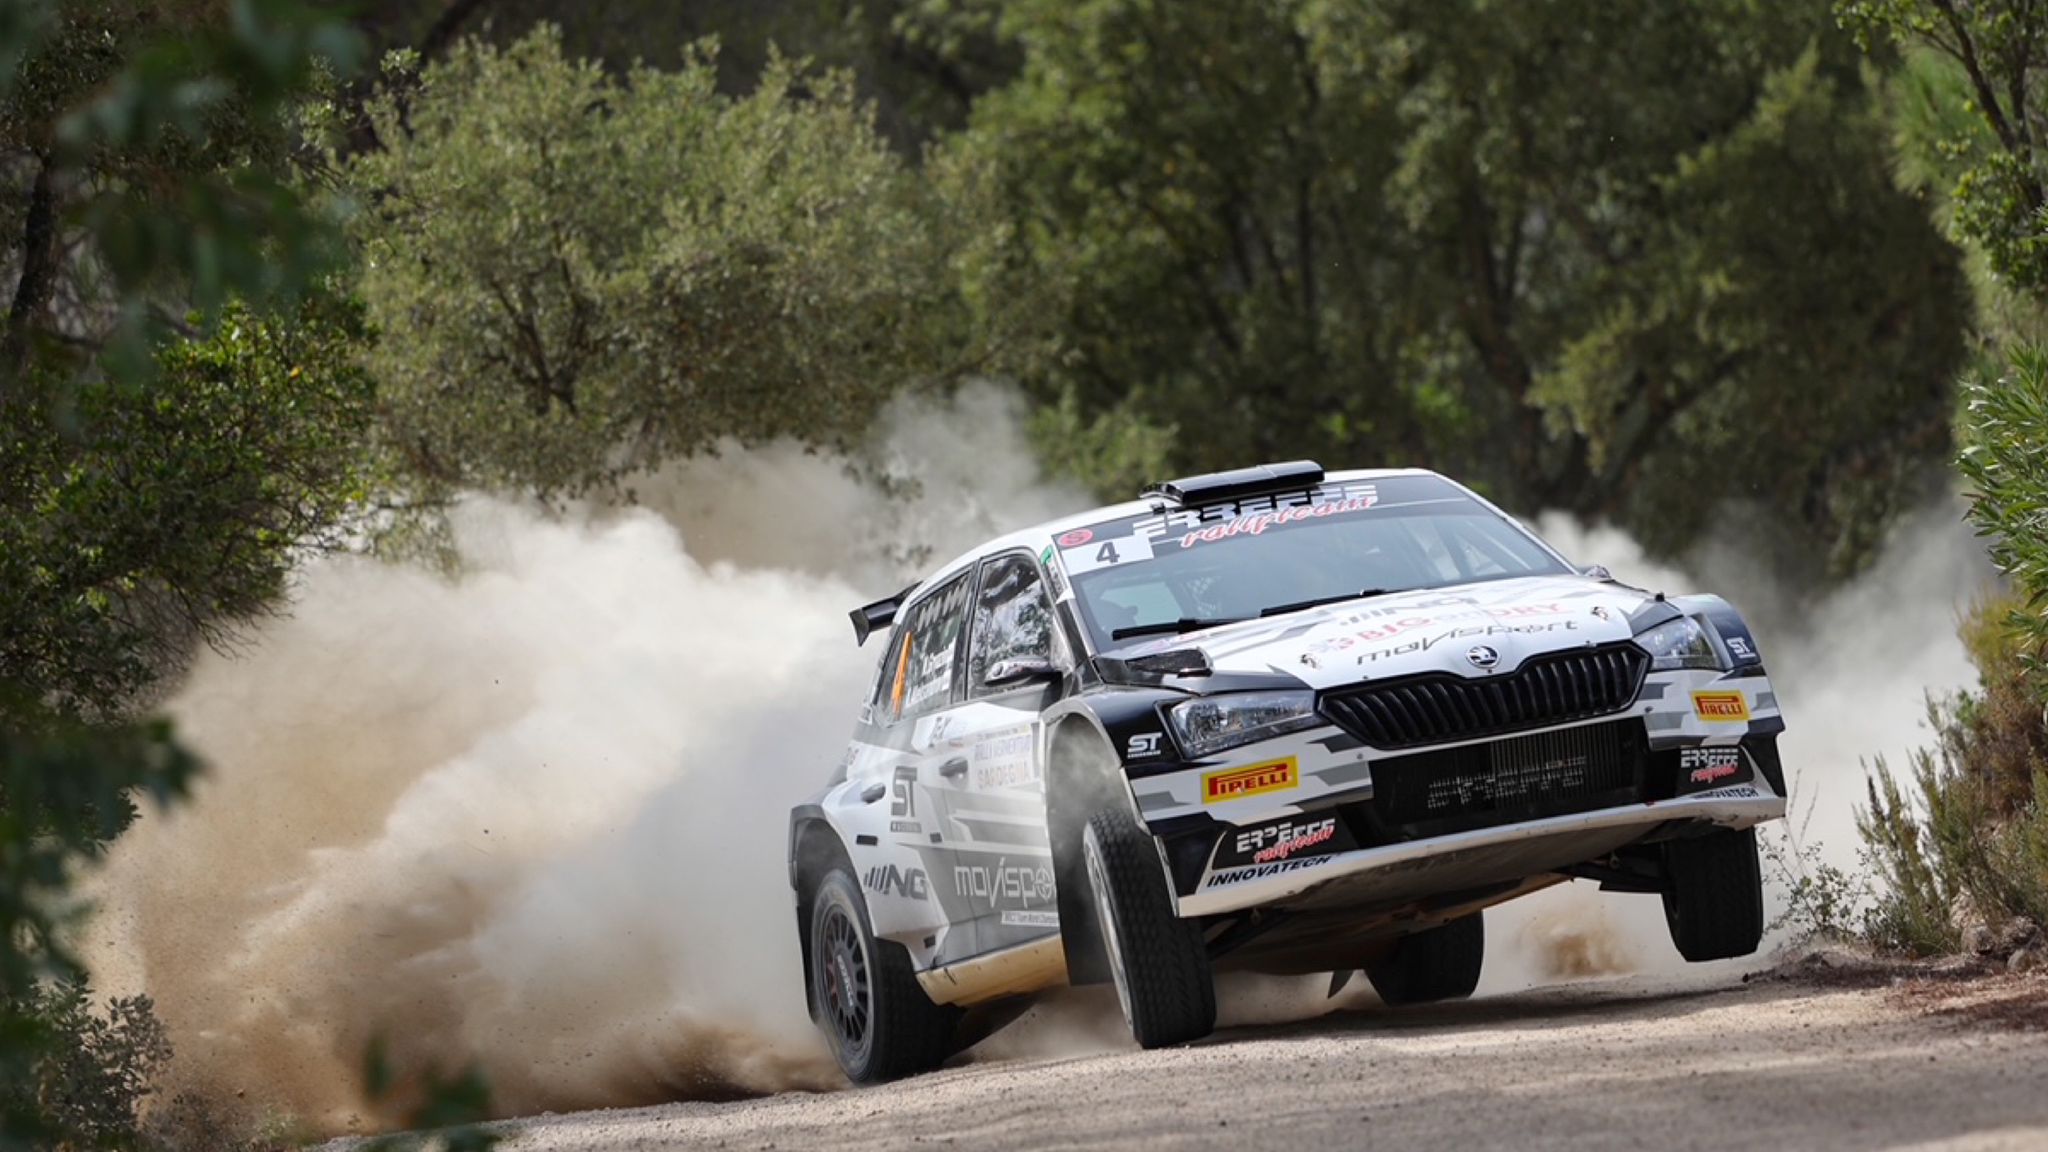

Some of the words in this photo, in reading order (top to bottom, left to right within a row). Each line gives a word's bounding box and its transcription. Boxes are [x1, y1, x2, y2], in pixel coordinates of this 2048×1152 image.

[1096, 541, 1120, 564] 4
[1695, 696, 1743, 715] PIRELLI
[1128, 732, 1162, 752] ST
[891, 765, 918, 818] ST
[1208, 763, 1288, 796] PIRELLI
[1206, 855, 1332, 888] INNOVATECH
